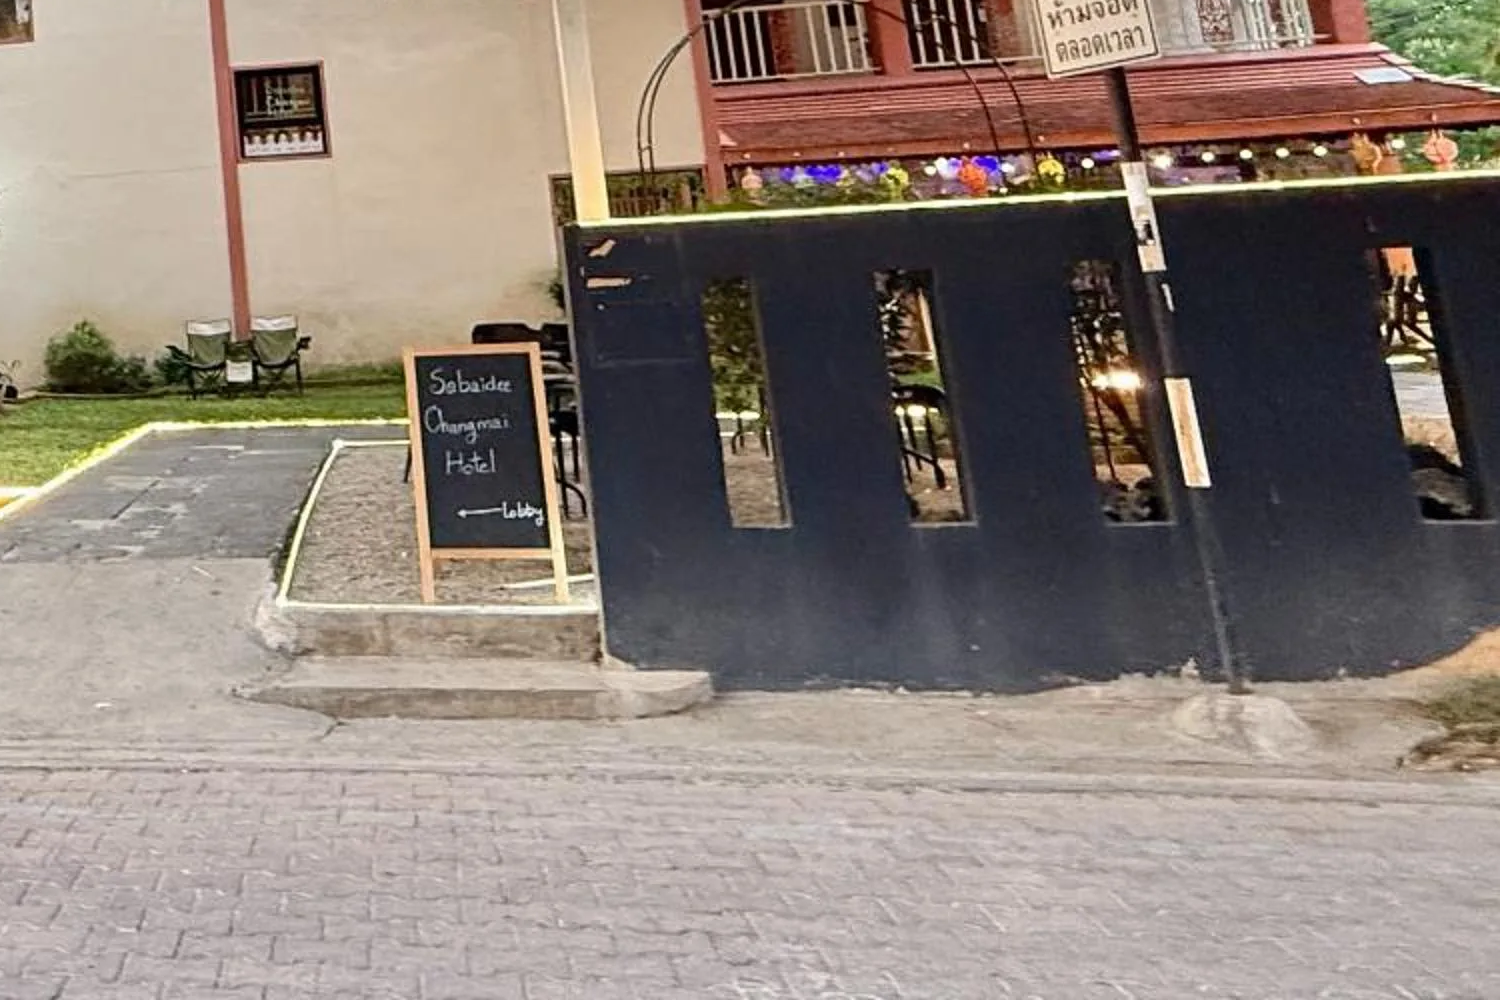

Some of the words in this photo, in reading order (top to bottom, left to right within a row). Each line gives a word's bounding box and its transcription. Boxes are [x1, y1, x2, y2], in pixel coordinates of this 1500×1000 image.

[1055, 25, 1146, 62] ตลอดเวลา
[429, 367, 513, 395] Sabaidee
[445, 448, 496, 475] Hotel
